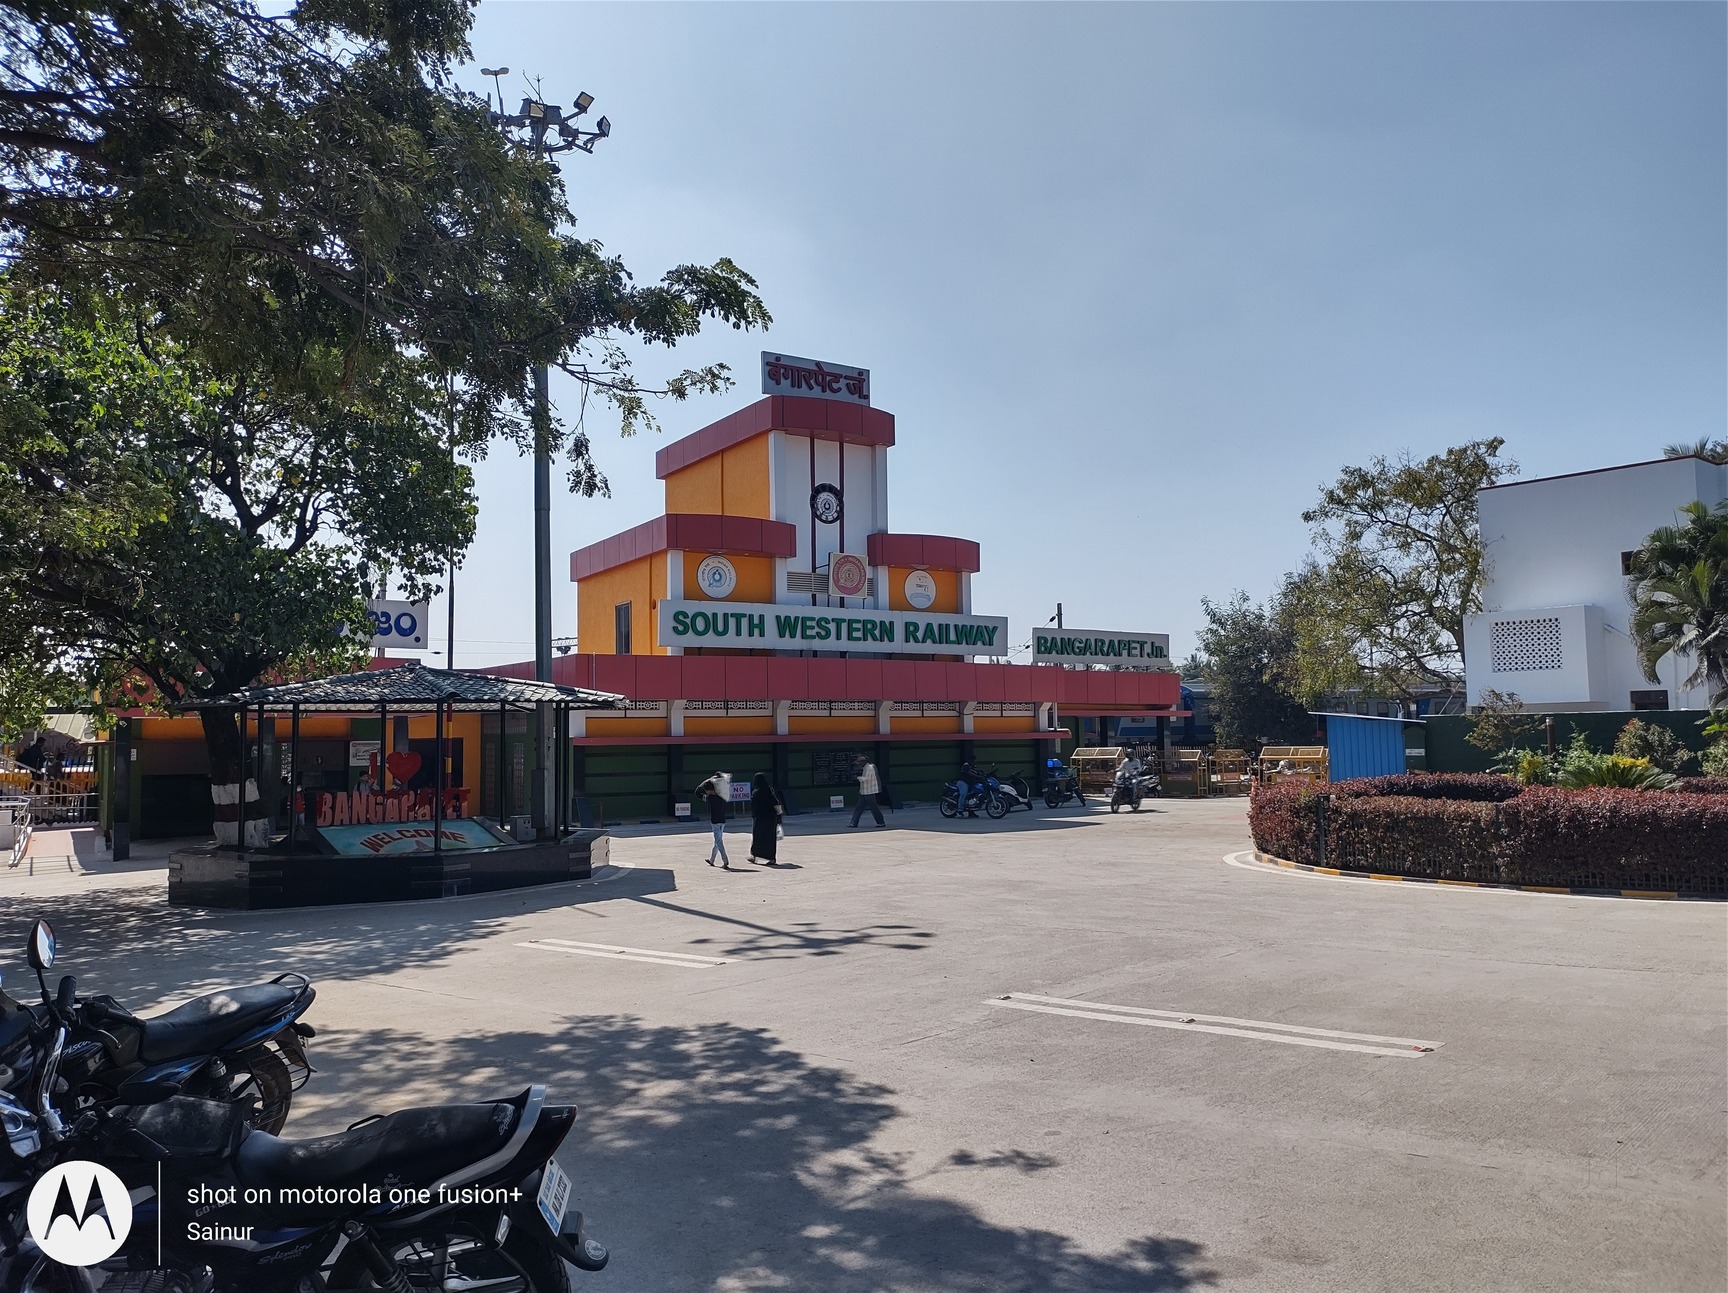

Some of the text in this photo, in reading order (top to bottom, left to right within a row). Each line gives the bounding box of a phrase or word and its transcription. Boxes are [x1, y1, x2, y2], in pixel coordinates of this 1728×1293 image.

[766, 356, 843, 393] बंगारपेट
[672, 610, 998, 647] SOUTH WESTERN RAILWAY
[1036, 635, 1167, 659] BANGARAPET Jn.
[360, 829, 467, 853] WELCOME
